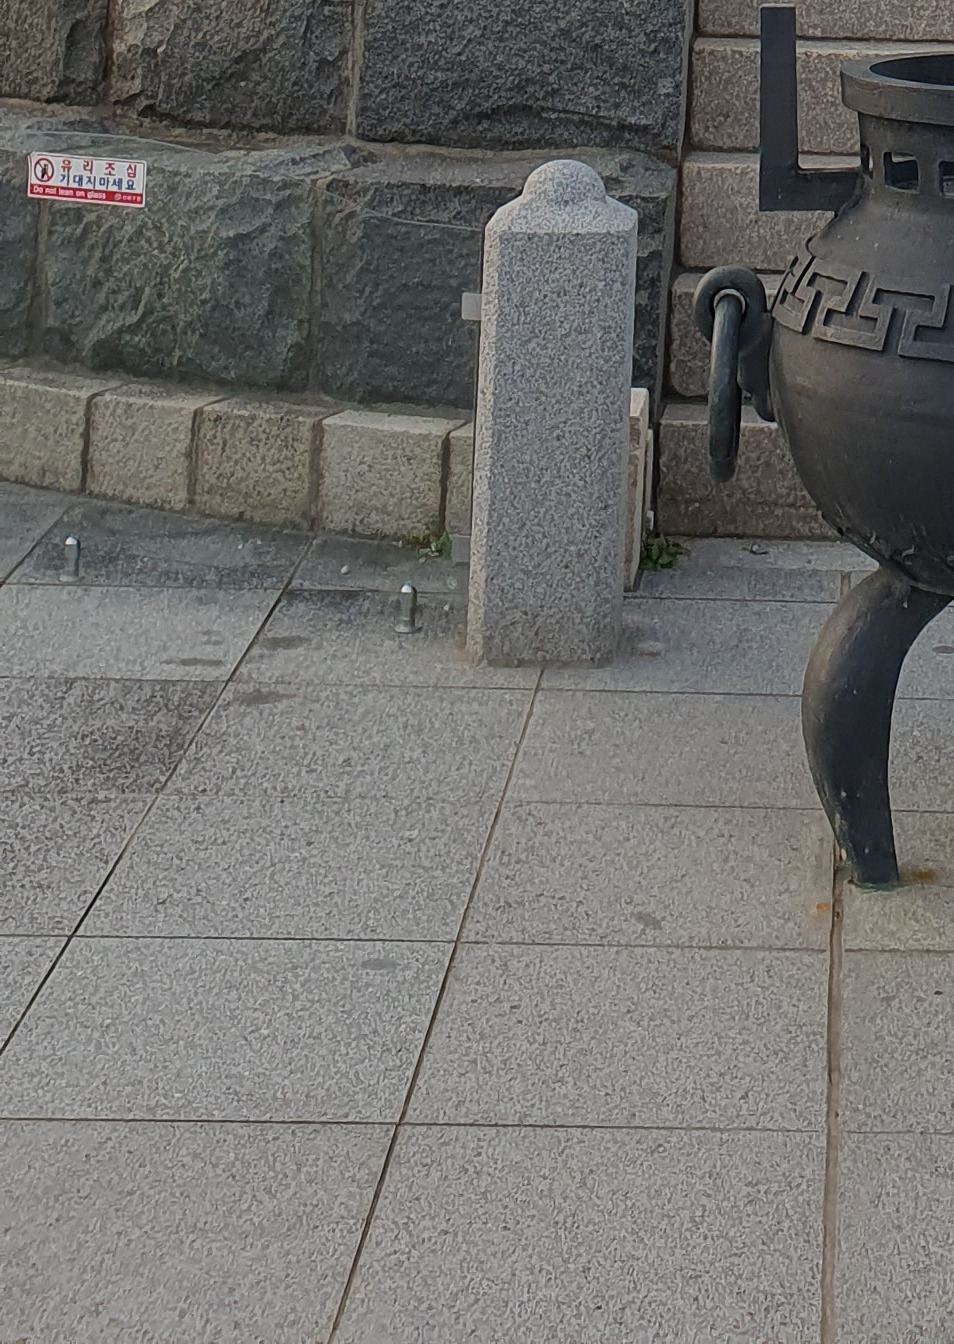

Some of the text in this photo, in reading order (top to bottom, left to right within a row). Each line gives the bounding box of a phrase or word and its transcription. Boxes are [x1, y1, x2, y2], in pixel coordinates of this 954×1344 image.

[61, 159, 137, 178] 유리조심
[60, 172, 137, 191] 기대지마세요
[33, 186, 43, 194] Do
[45, 187, 57, 195] not
[87, 189, 106, 200] glass
